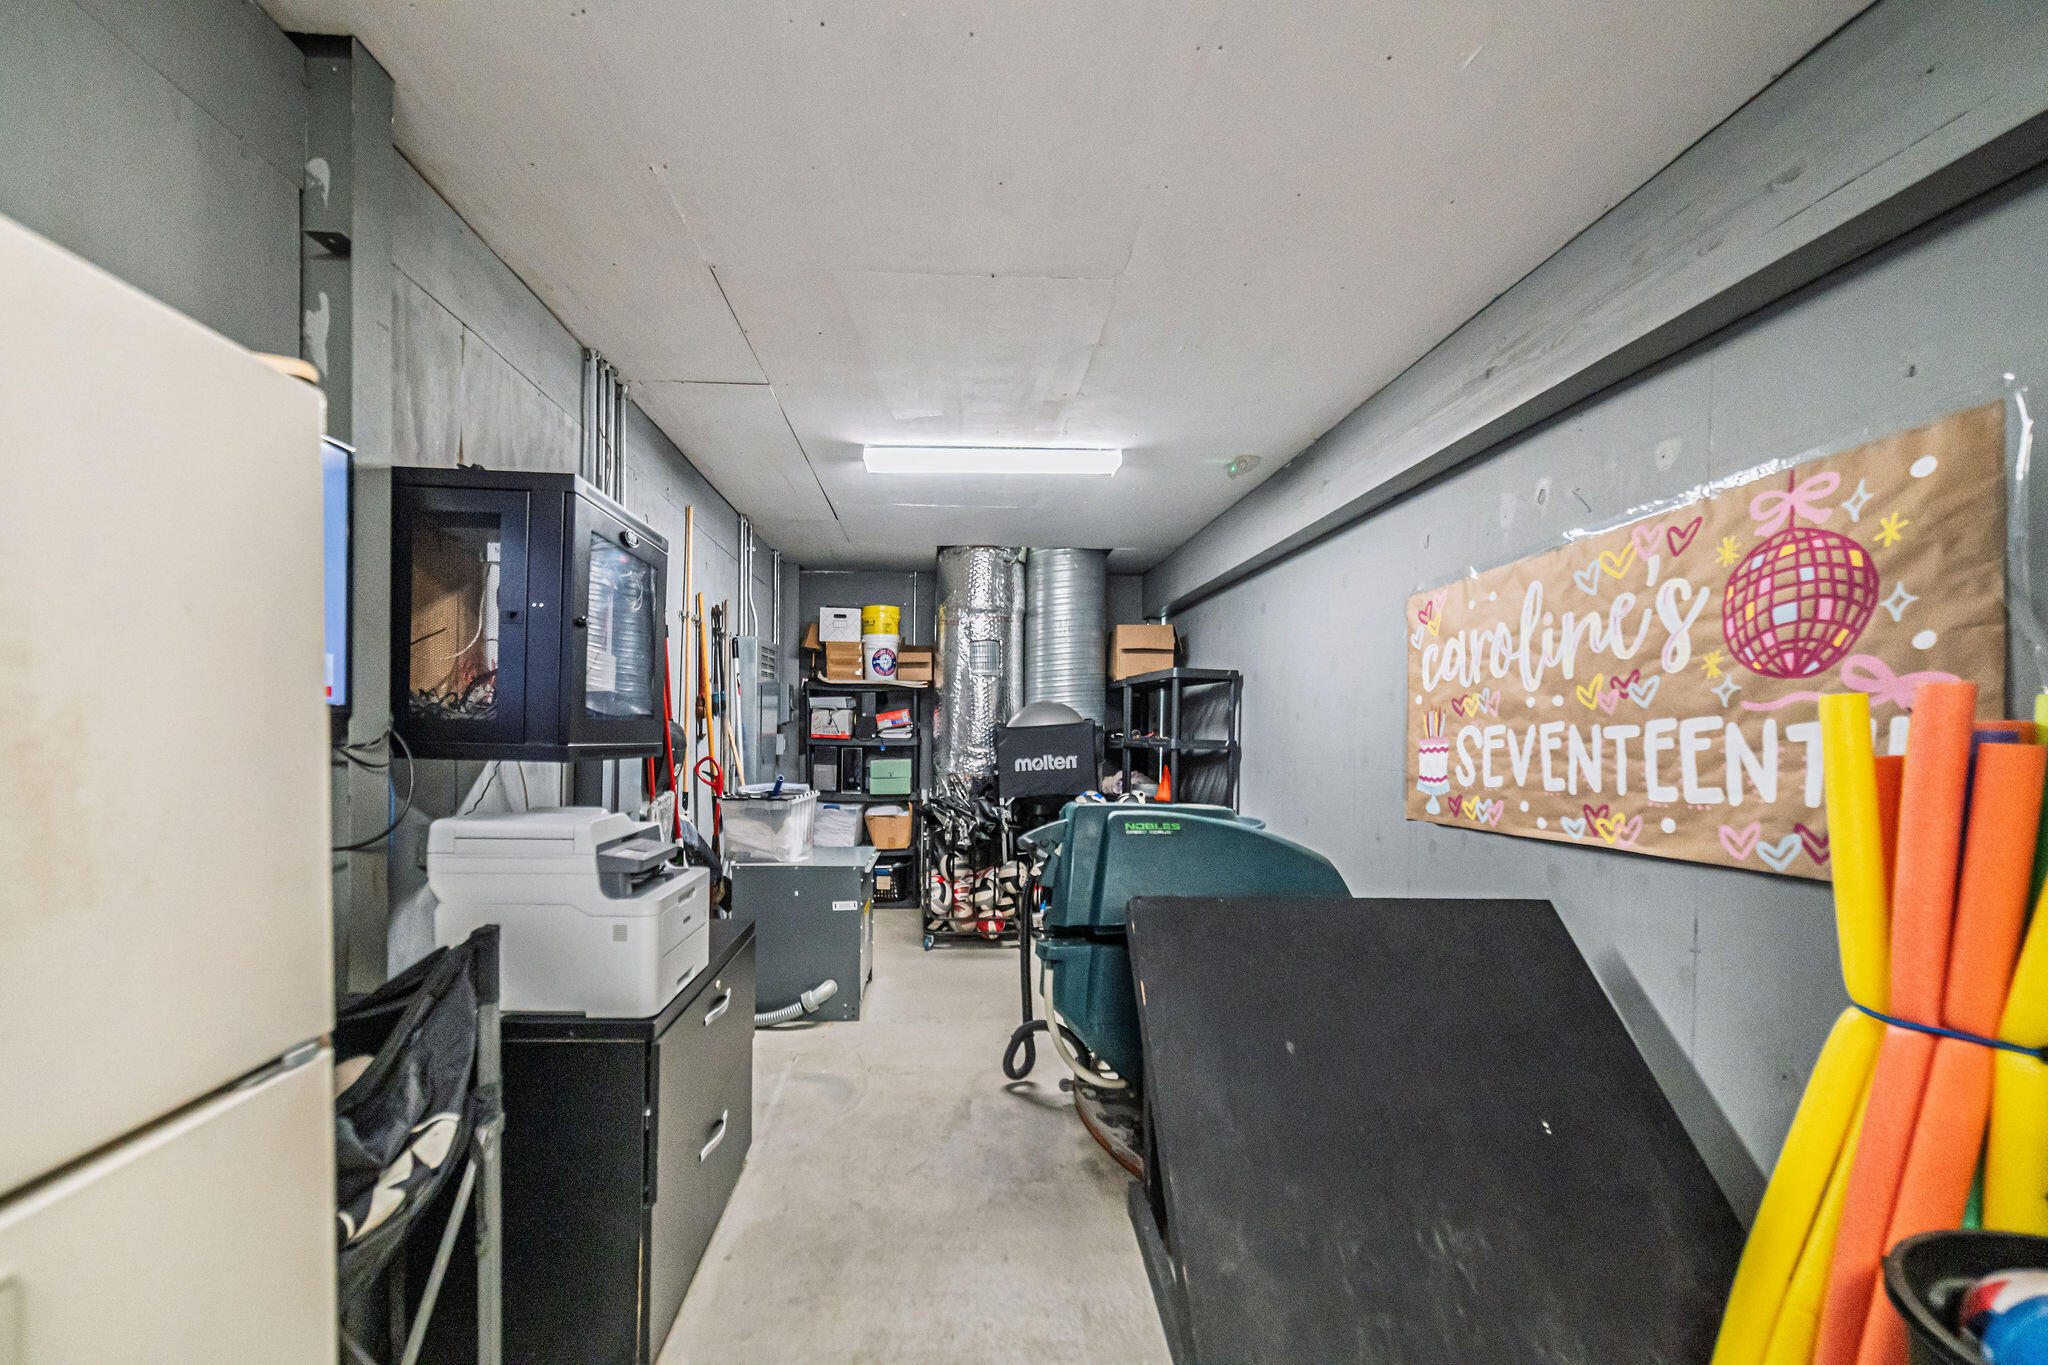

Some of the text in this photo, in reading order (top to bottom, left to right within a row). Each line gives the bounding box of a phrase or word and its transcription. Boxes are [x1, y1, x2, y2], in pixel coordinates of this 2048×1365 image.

[1421, 555, 1710, 693] caroline's
[1014, 754, 1078, 772] molten
[1455, 716, 1910, 809] SEVENTEENT
[1124, 822, 1181, 831] NOBLES
